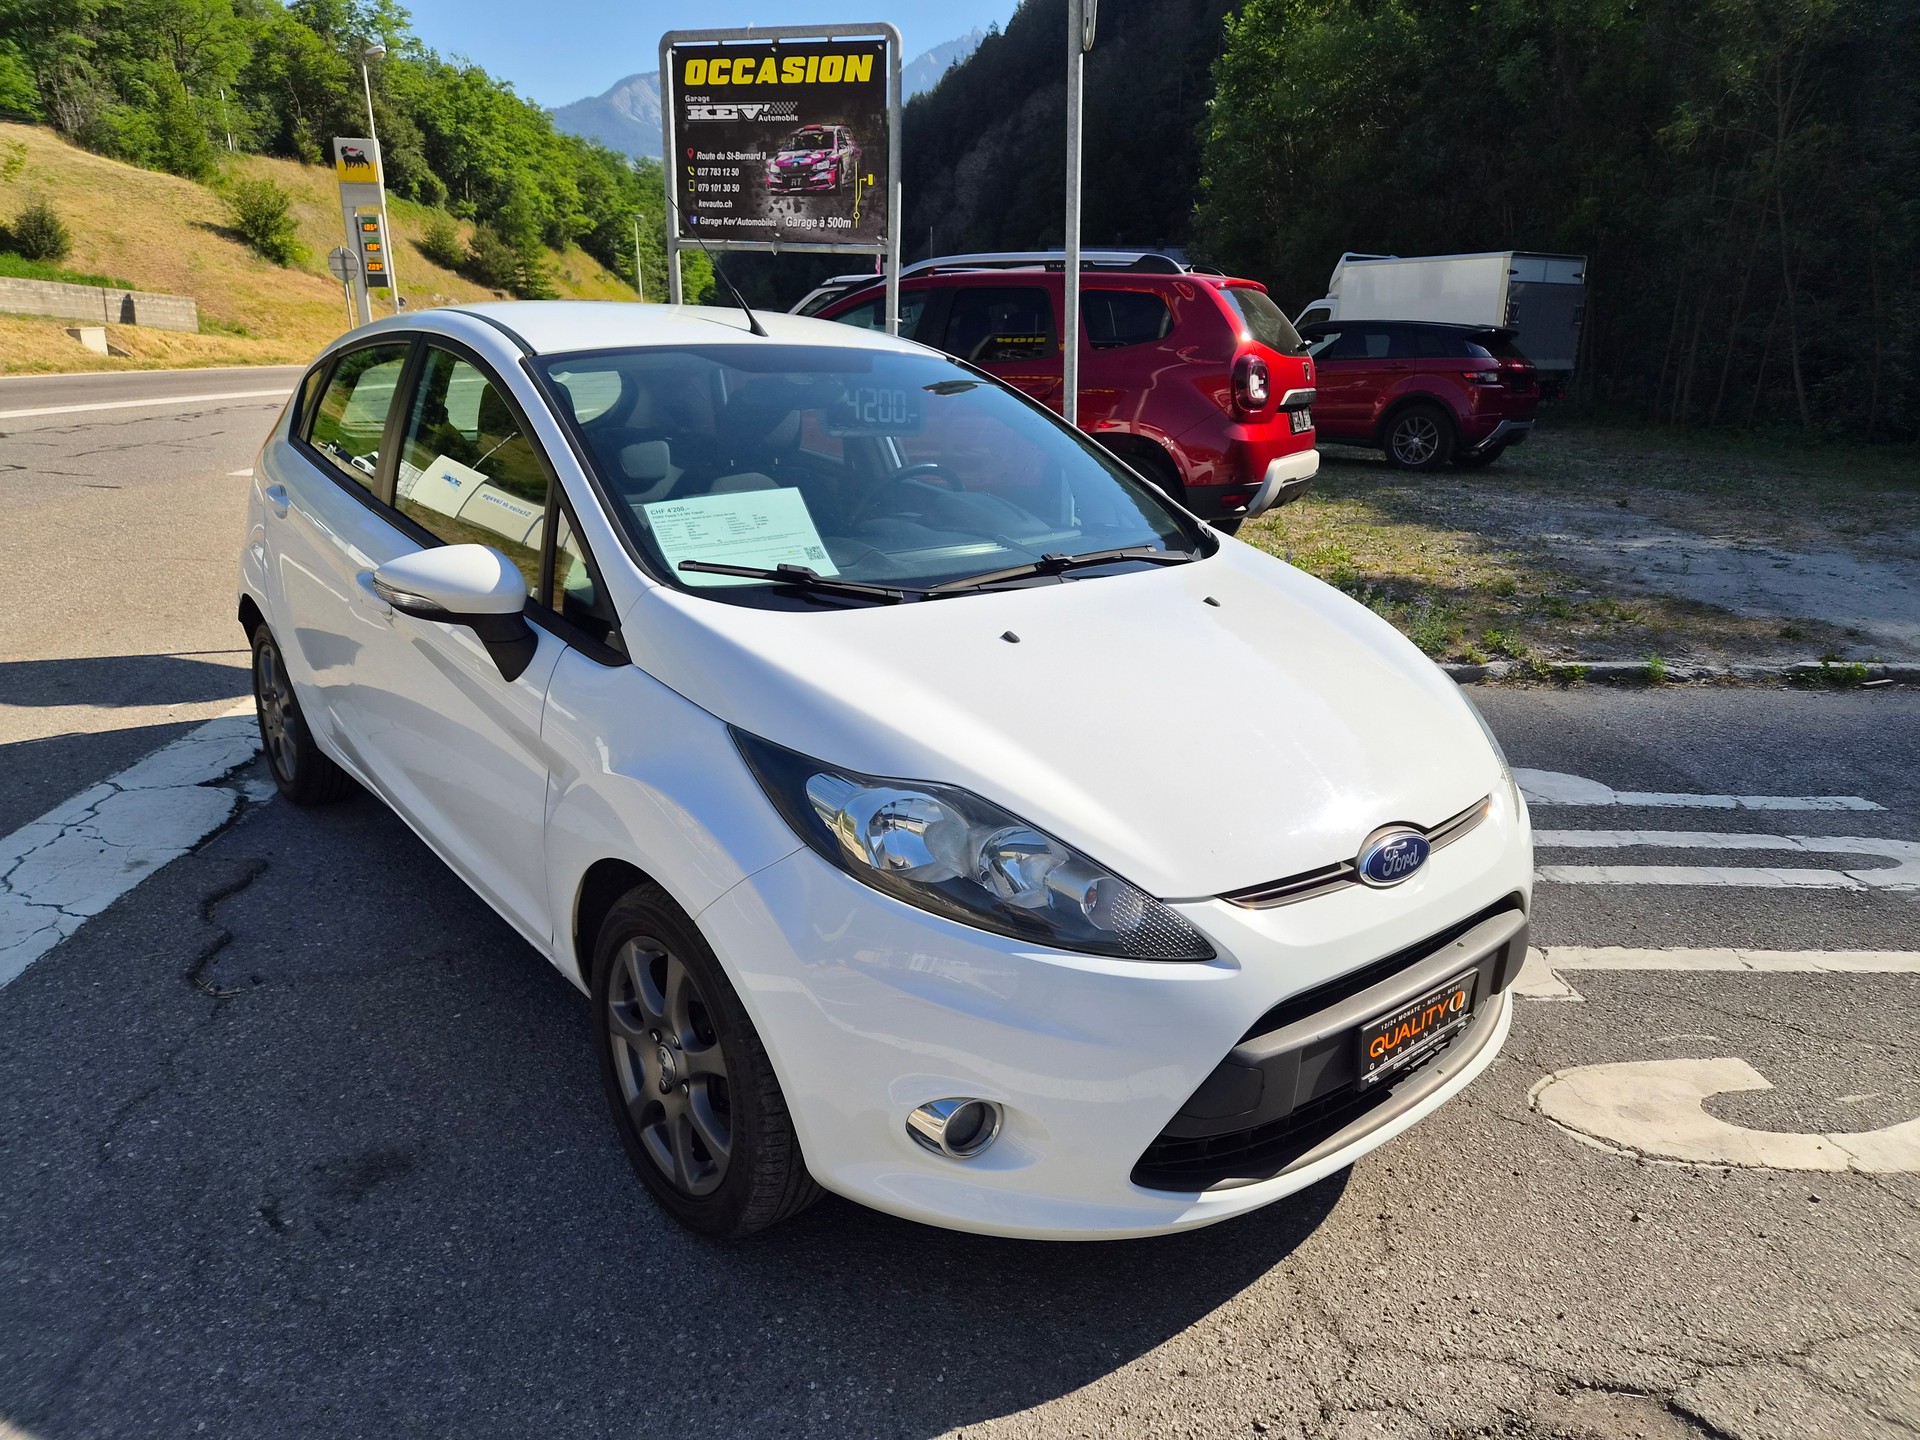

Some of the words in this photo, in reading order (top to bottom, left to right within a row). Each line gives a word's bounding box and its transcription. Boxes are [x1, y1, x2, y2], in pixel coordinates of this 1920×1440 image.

[684, 55, 874, 86] OCCASION
[684, 95, 710, 103] Garage
[697, 151, 716, 160] Route
[716, 151, 726, 160] du
[726, 151, 761, 160] St-Bernard
[761, 151, 767, 160] 8
[697, 167, 709, 176] 027
[710, 167, 721, 176] 783
[722, 167, 730, 176] 12
[731, 167, 740, 176] 50
[697, 183, 709, 192] 079
[710, 183, 722, 192] 101
[722, 184, 731, 192] 30
[731, 184, 740, 193] 50
[698, 199, 733, 208] kevauto.ch
[700, 216, 722, 227] Garage
[785, 216, 817, 230] Garage
[819, 217, 825, 228] à
[827, 217, 852, 229] 500m
[1382, 841, 1420, 877] Ford
[1398, 1004, 1421, 1021] MONATE
[1427, 995, 1441, 1005] MOIS
